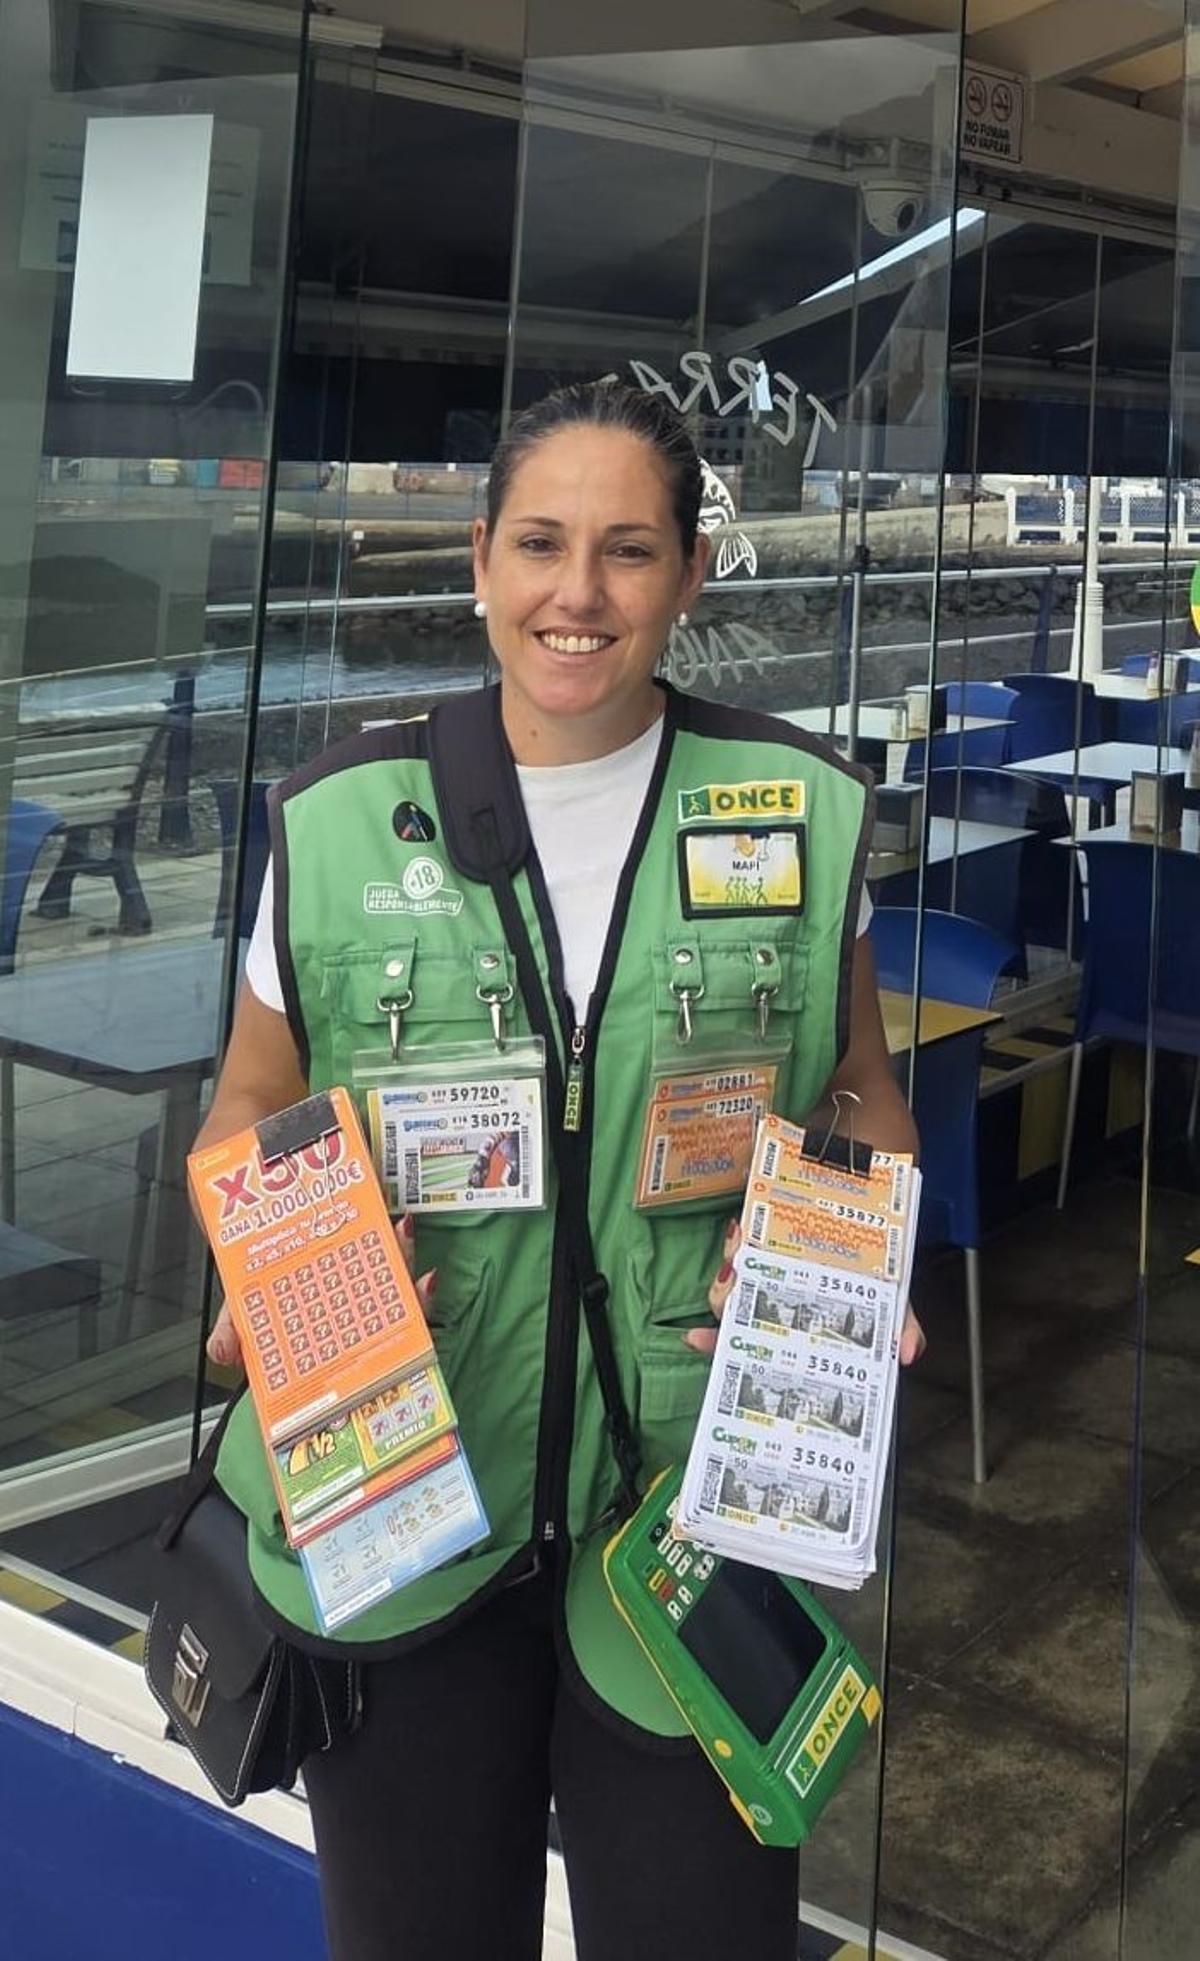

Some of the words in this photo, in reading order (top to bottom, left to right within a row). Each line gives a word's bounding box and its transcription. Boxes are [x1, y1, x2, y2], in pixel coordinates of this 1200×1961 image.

[966, 120, 978, 133] NO
[963, 133, 977, 148] NO
[716, 787, 794, 811] ONCE
[450, 1086, 500, 1102] 59720
[566, 1084, 579, 1126] ONCE
[471, 1111, 521, 1129] 38072
[219, 1219, 252, 1244] GANA
[819, 1275, 877, 1300] 35840
[807, 1355, 868, 1383] 35840
[384, 1420, 427, 1451] PREMIO
[733, 1456, 749, 1470] 50
[792, 1446, 856, 1476] 35840
[813, 1679, 858, 1755] ONCE
